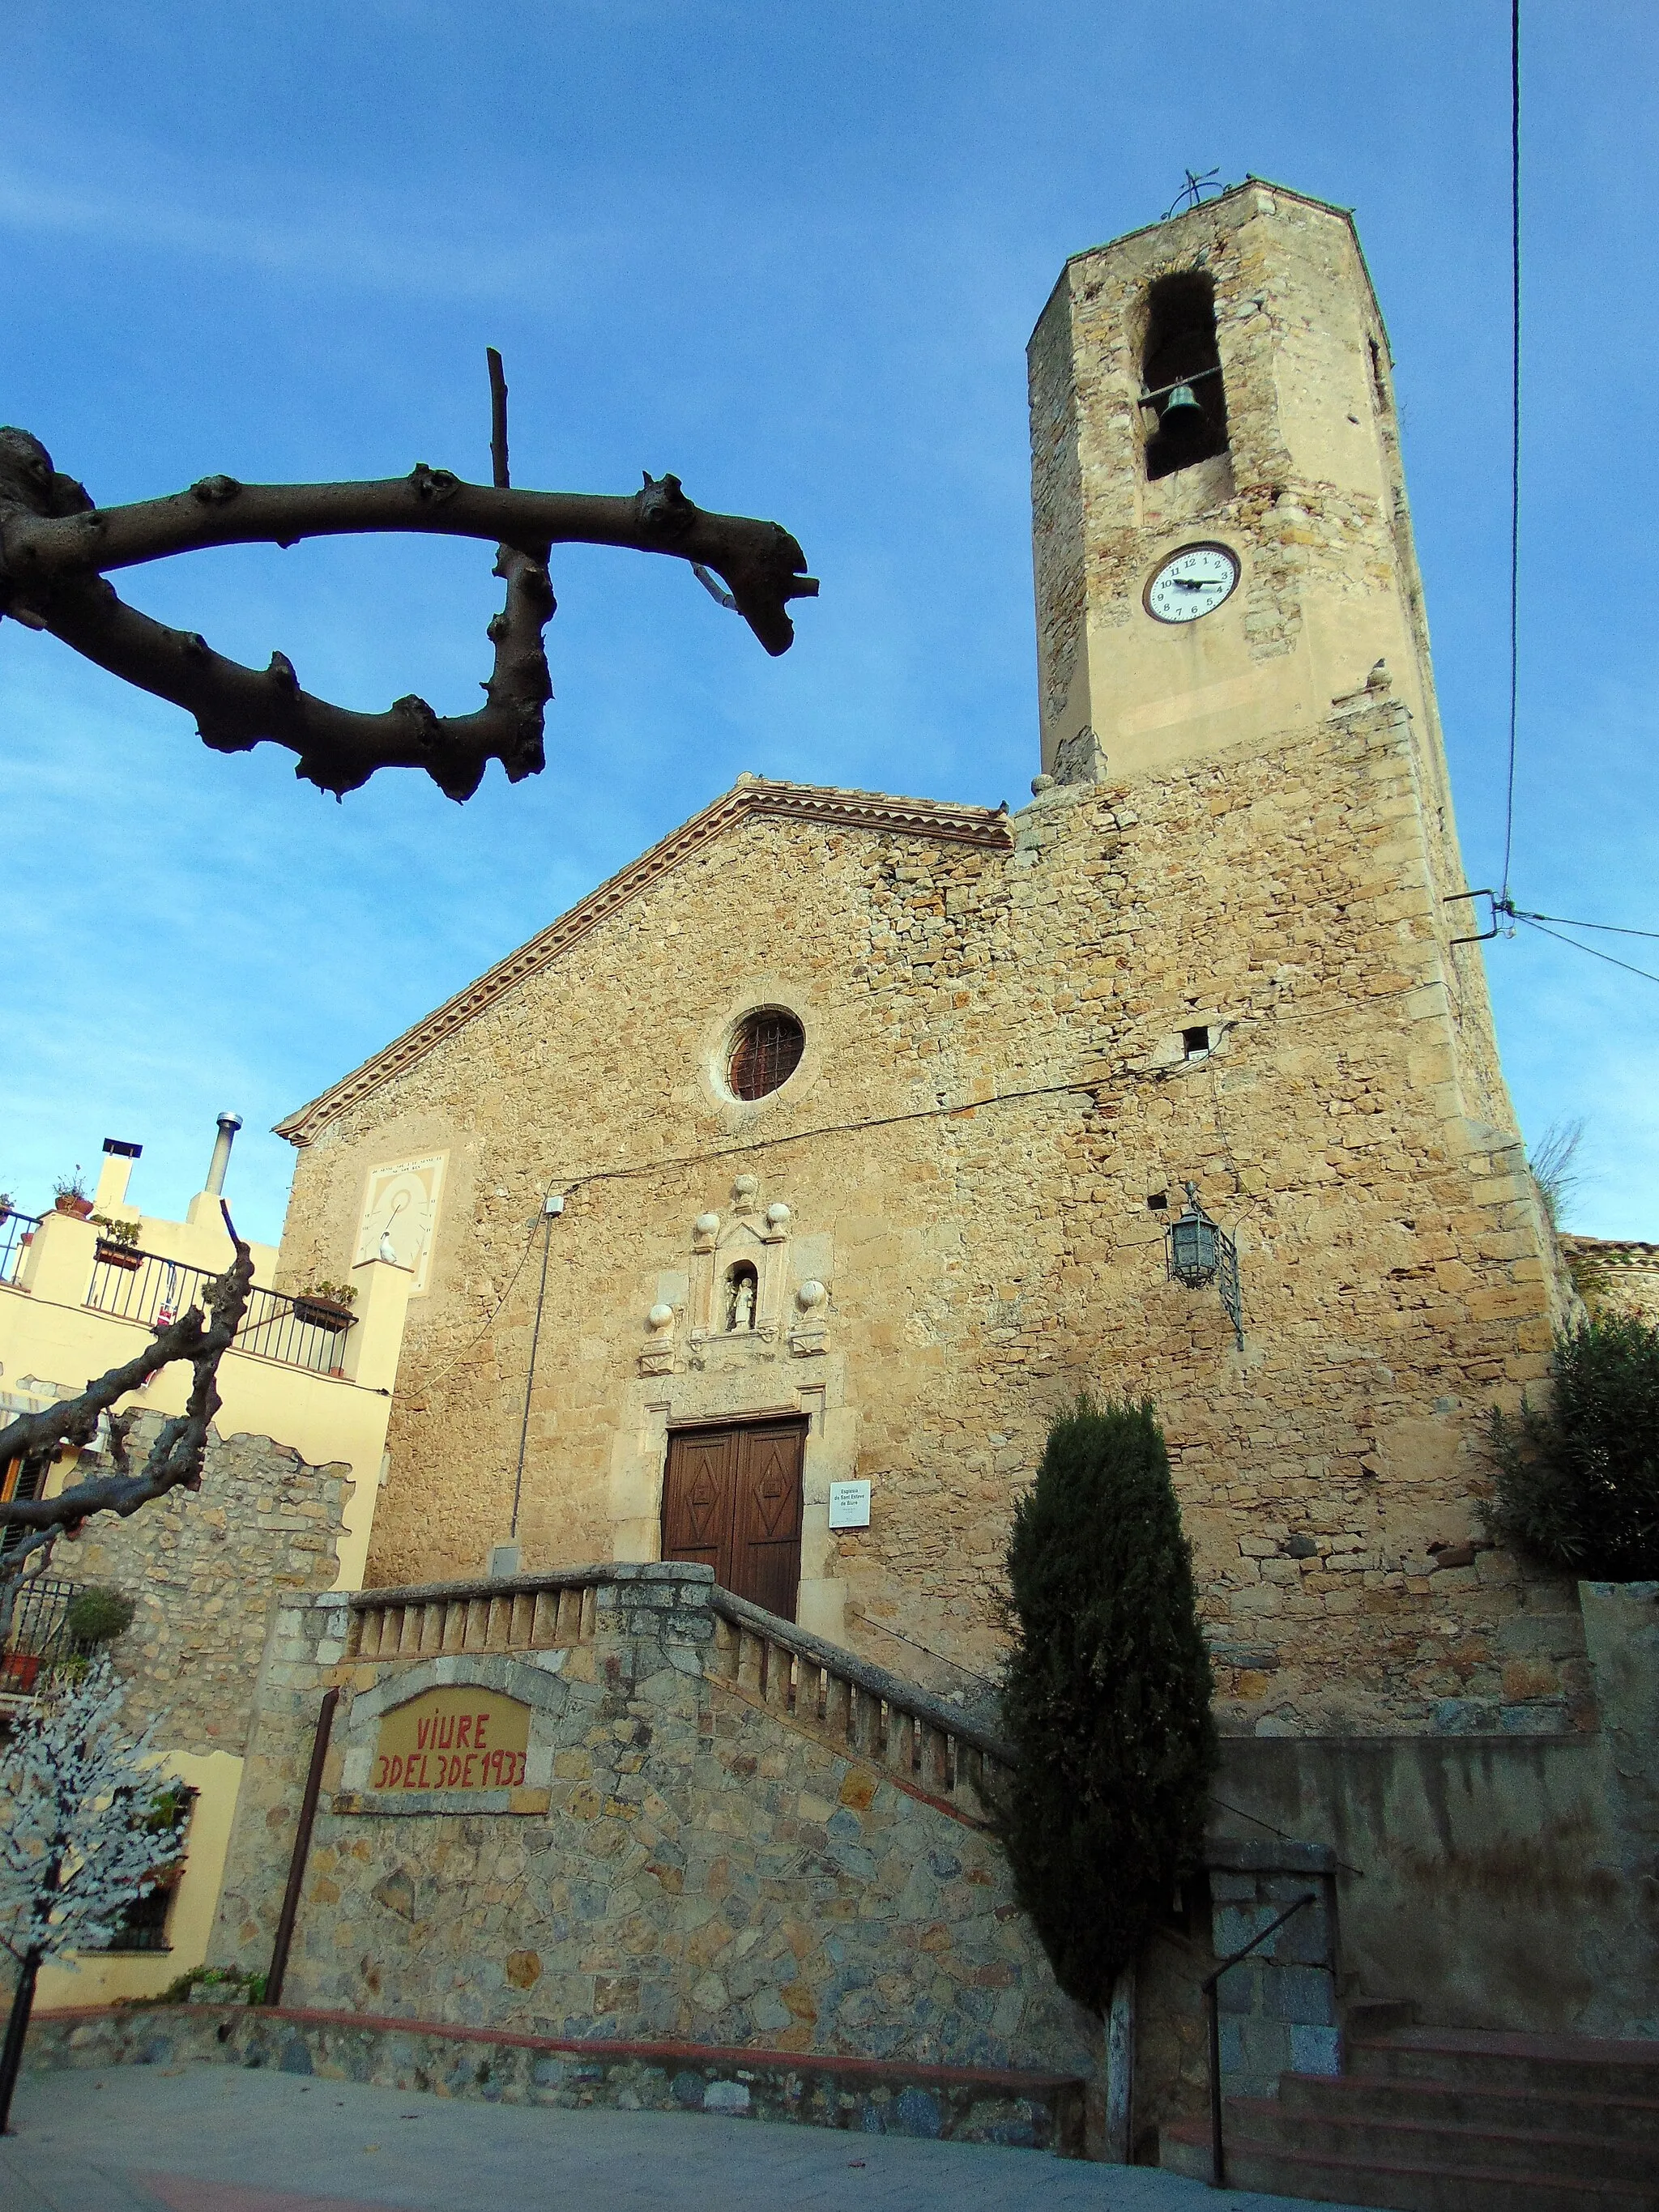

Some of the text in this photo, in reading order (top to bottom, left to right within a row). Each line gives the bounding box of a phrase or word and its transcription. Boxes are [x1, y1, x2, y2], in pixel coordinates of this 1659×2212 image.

[1184, 559, 1196, 569] 12
[1214, 560, 1222, 569] 2
[1171, 567, 1180, 577] 11
[1161, 580, 1172, 589] 10
[1216, 586, 1223, 594] 4
[1206, 597, 1213, 606] 5
[1163, 603, 1171, 612] 8
[1191, 605, 1198, 613] 6
[480, 1749, 527, 1787] 1933
